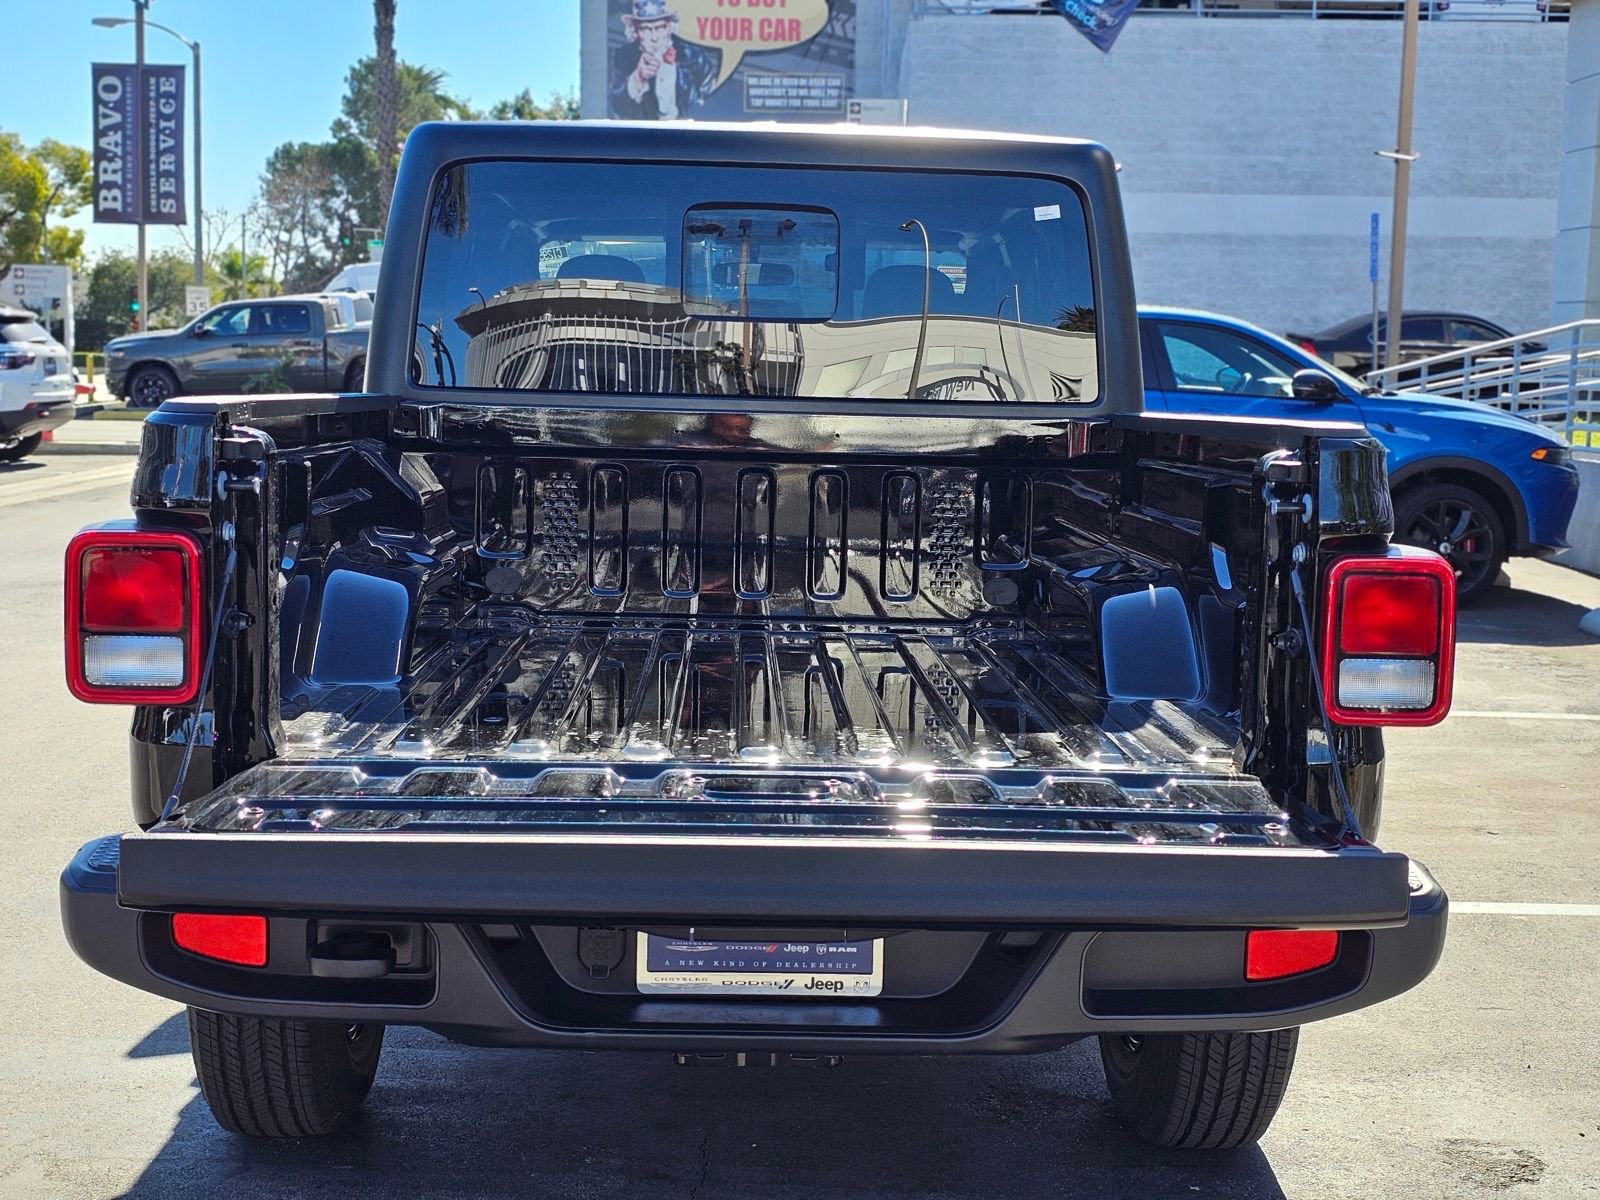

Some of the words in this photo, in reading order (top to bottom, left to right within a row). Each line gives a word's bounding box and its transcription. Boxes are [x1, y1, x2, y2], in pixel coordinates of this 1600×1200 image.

[696, 16, 753, 41] YOUR
[758, 17, 801, 42] CAR
[97, 75, 123, 213] BRAVO
[159, 77, 177, 214] SERVICE
[190, 302, 208, 313] 35
[784, 943, 810, 954] Jeep
[776, 961, 857, 969] DEALERSHIP
[804, 976, 844, 993] Jeep
